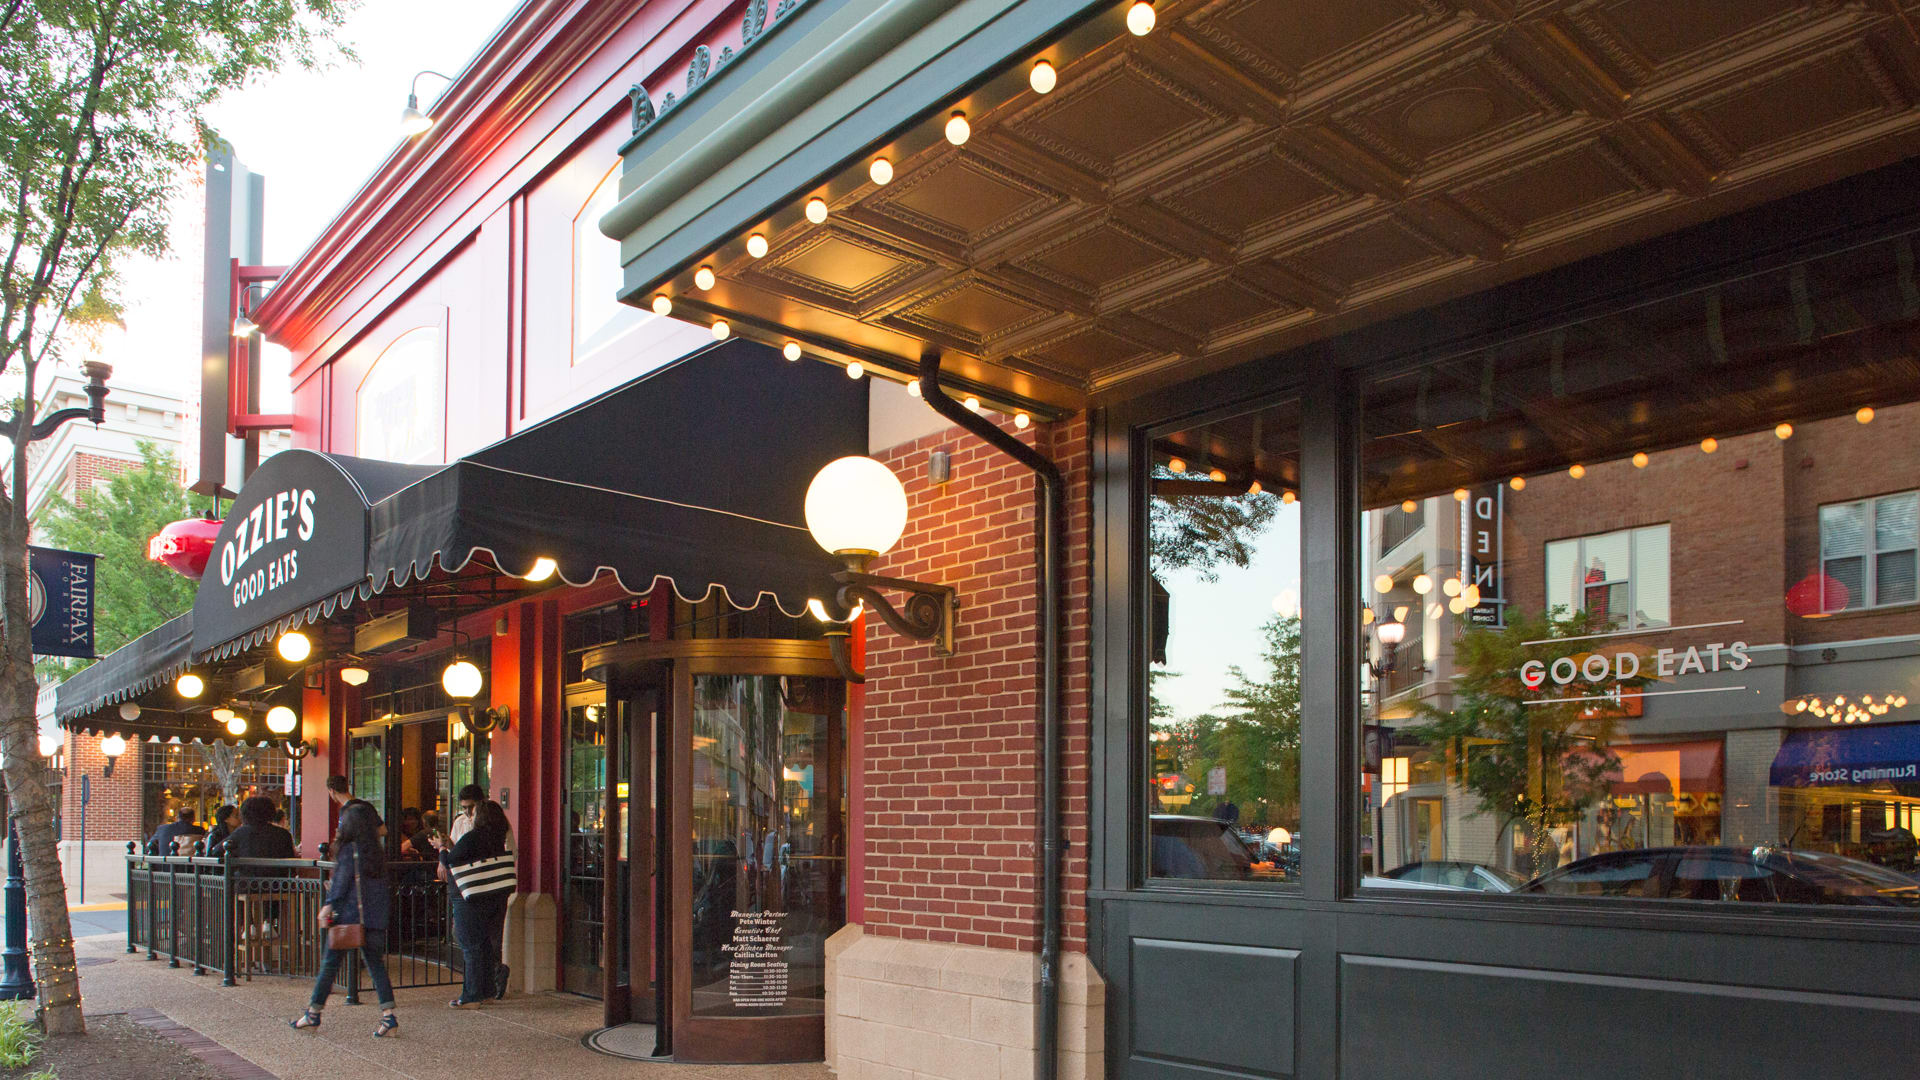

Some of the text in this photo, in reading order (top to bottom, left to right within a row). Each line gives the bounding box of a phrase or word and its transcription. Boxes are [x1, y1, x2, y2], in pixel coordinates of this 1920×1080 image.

[221, 488, 315, 586] OZZIE'S
[70, 562, 88, 645] FAIRFAX
[233, 549, 298, 608] GOOD EATS
[1520, 641, 1749, 687] GOOD EATS
[730, 910, 762, 918] Managing
